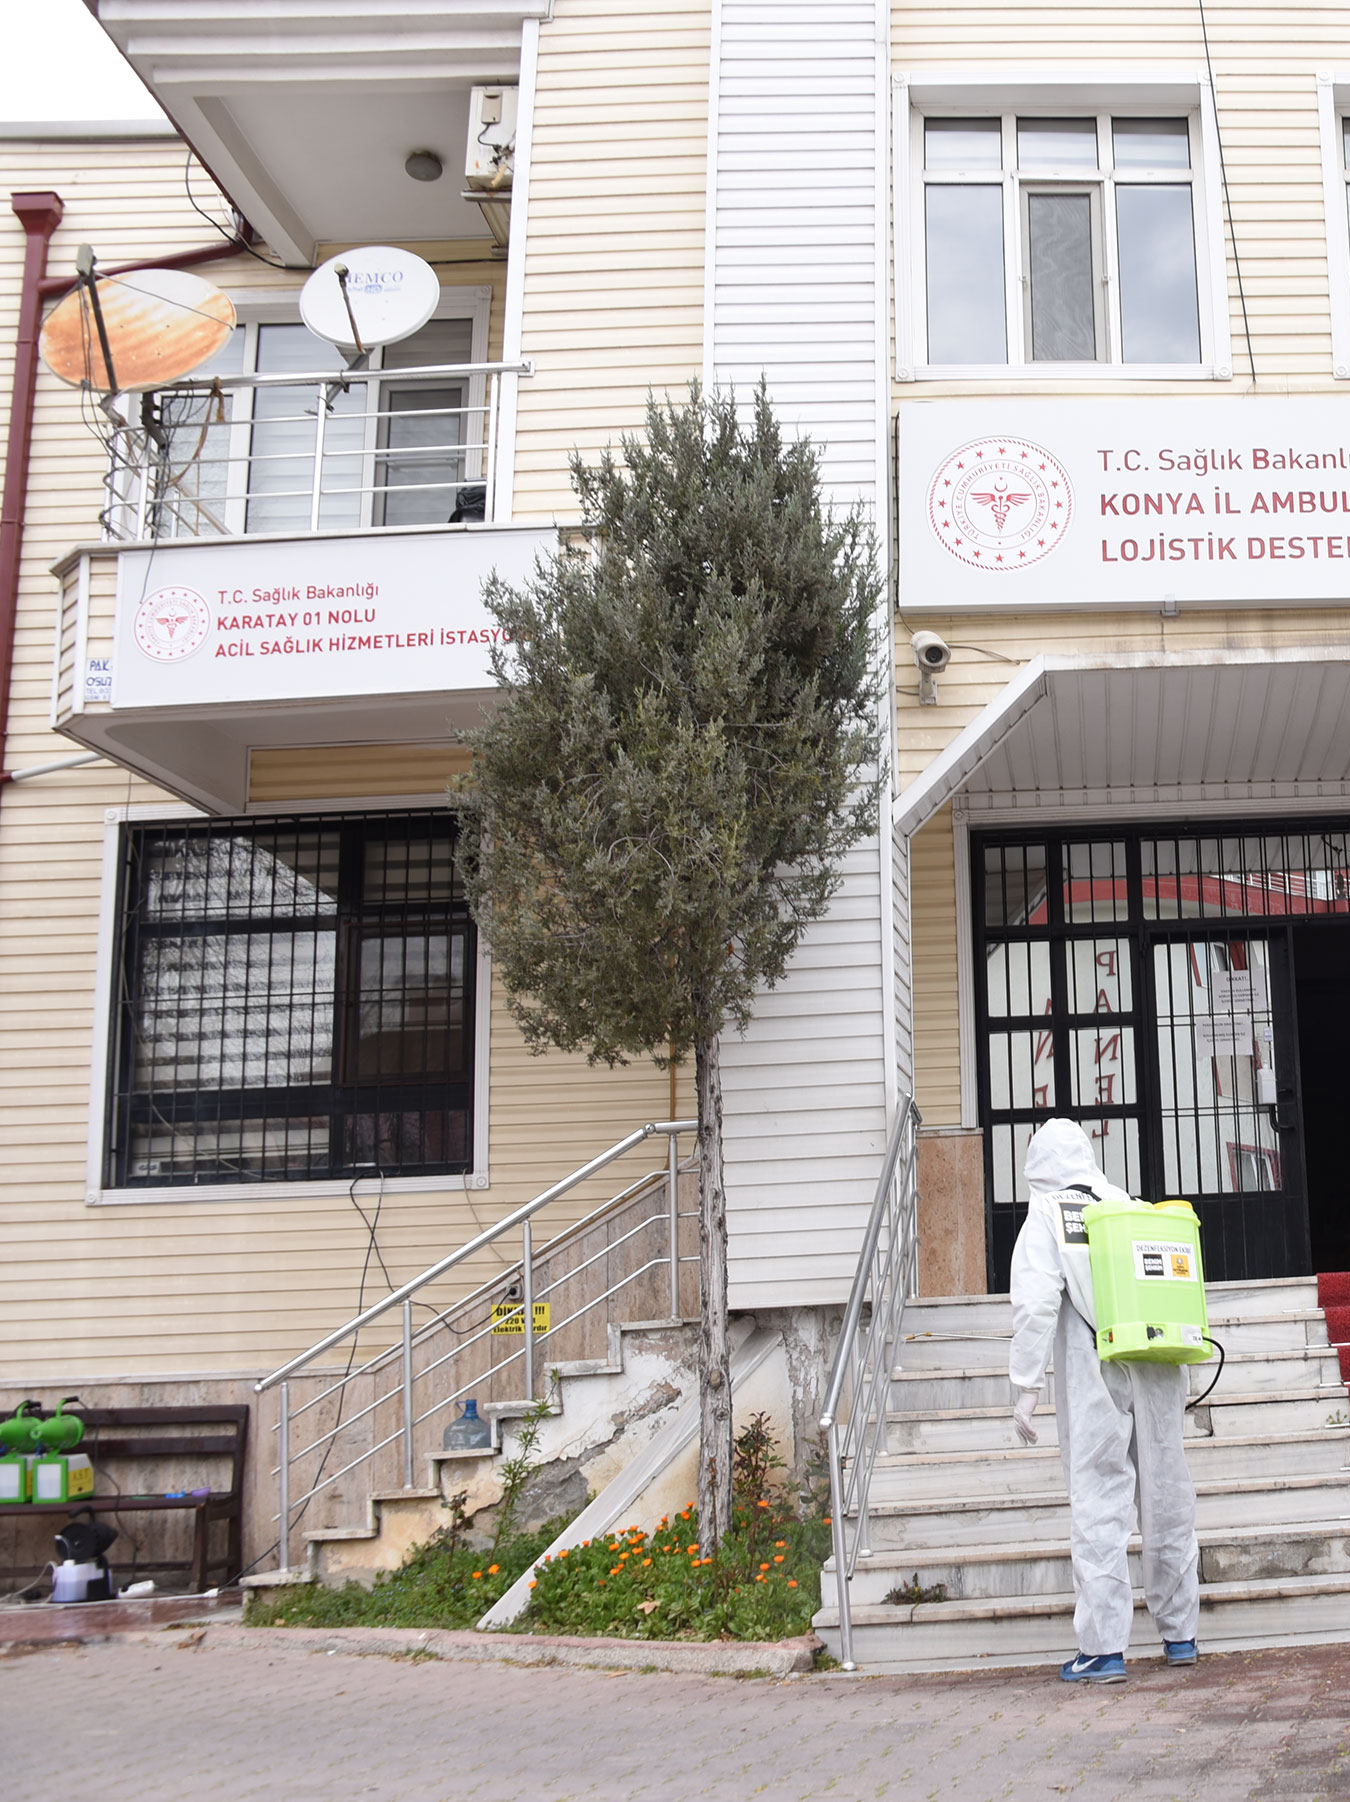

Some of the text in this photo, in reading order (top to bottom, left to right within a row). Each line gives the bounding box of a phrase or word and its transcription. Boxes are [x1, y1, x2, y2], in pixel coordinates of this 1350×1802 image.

[1097, 449, 1149, 471] T.C.
[1158, 447, 1244, 477] Sağlık
[1100, 492, 1205, 516] KONYA
[1214, 486, 1242, 514] İL
[1101, 531, 1238, 562] LOJİSTİK
[217, 581, 379, 606] T.C. Sağlık Bakanlığı
[217, 608, 376, 631] KARATAY 01 NOLU
[215, 639, 255, 658] ACİL
[260, 636, 323, 656] SAĞLIK
[328, 628, 434, 652] HİZMETLERİ
[1065, 1222, 1088, 1235] ŞEH
[504, 1317, 519, 1325] 220
